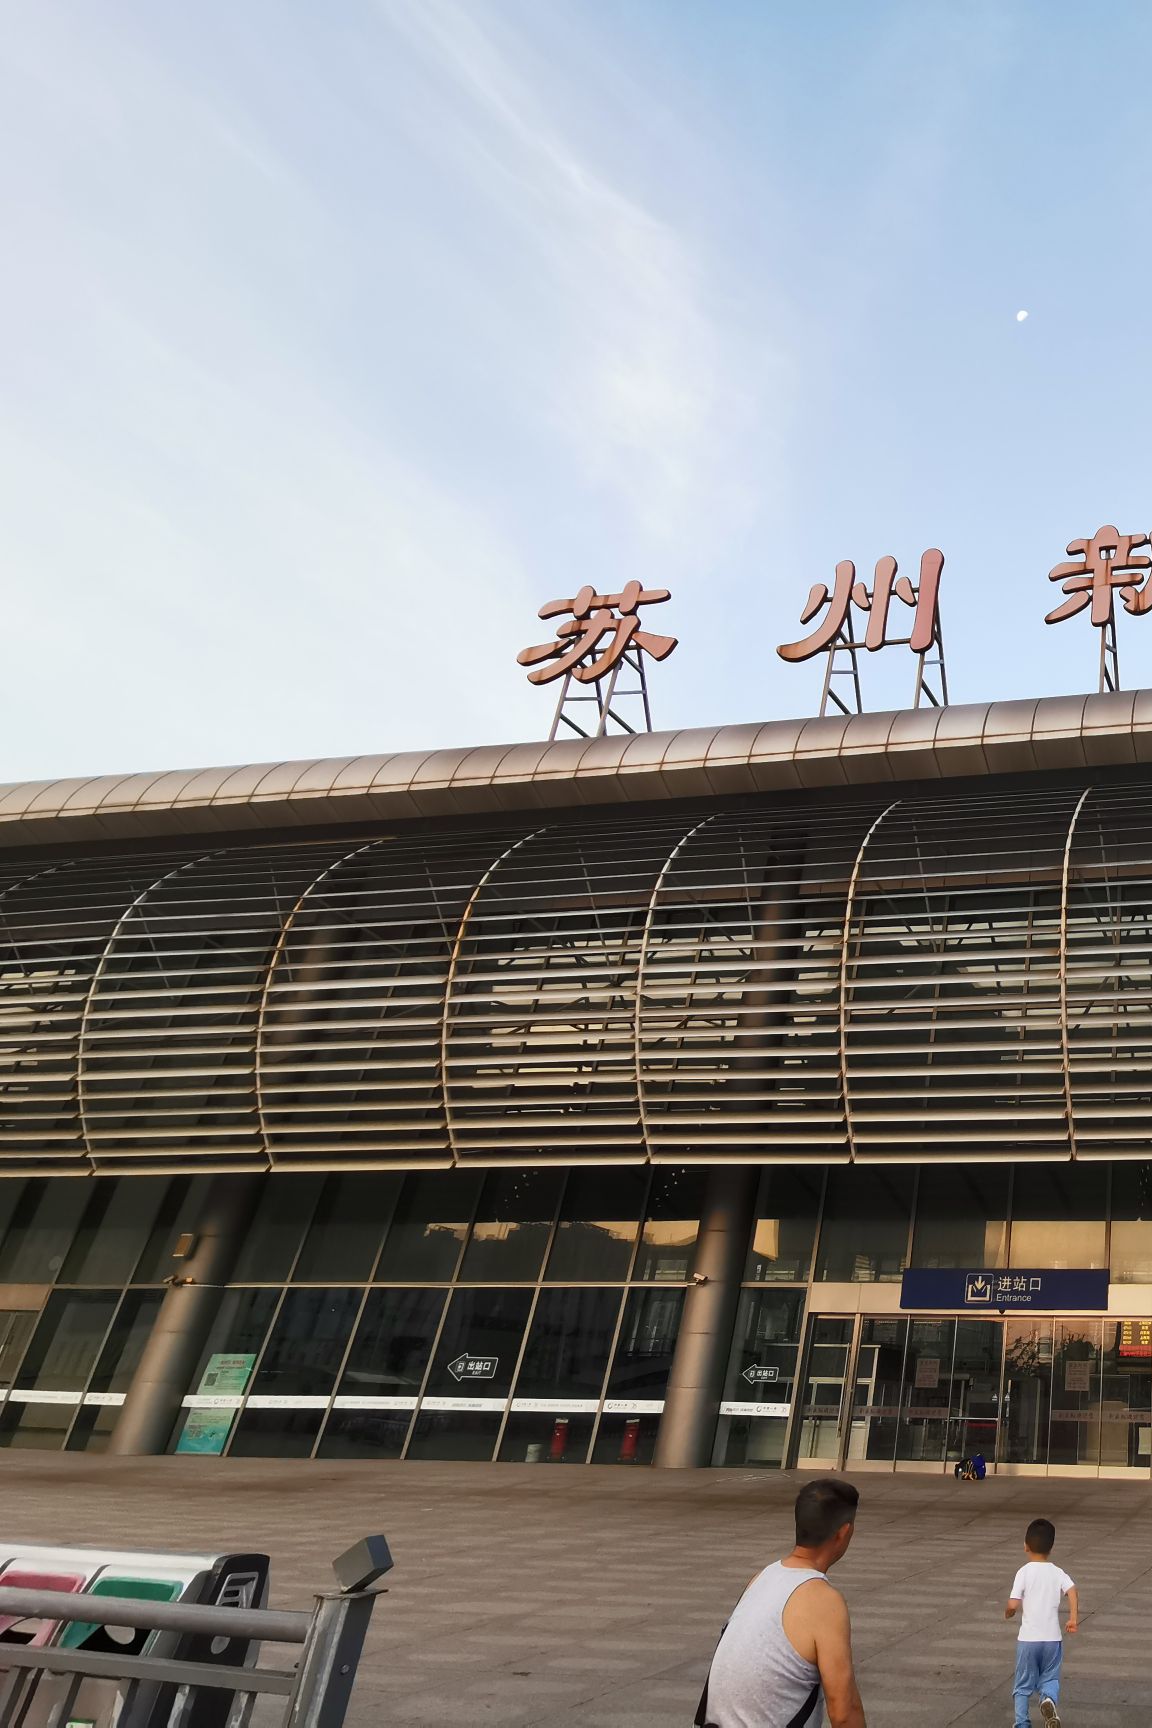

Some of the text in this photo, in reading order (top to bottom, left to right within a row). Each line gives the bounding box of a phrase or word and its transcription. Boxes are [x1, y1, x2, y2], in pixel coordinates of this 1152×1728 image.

[997, 1275, 1042, 1291] 进站口
[996, 1293, 1032, 1302] Entrance
[467, 1361, 492, 1370] 出站口
